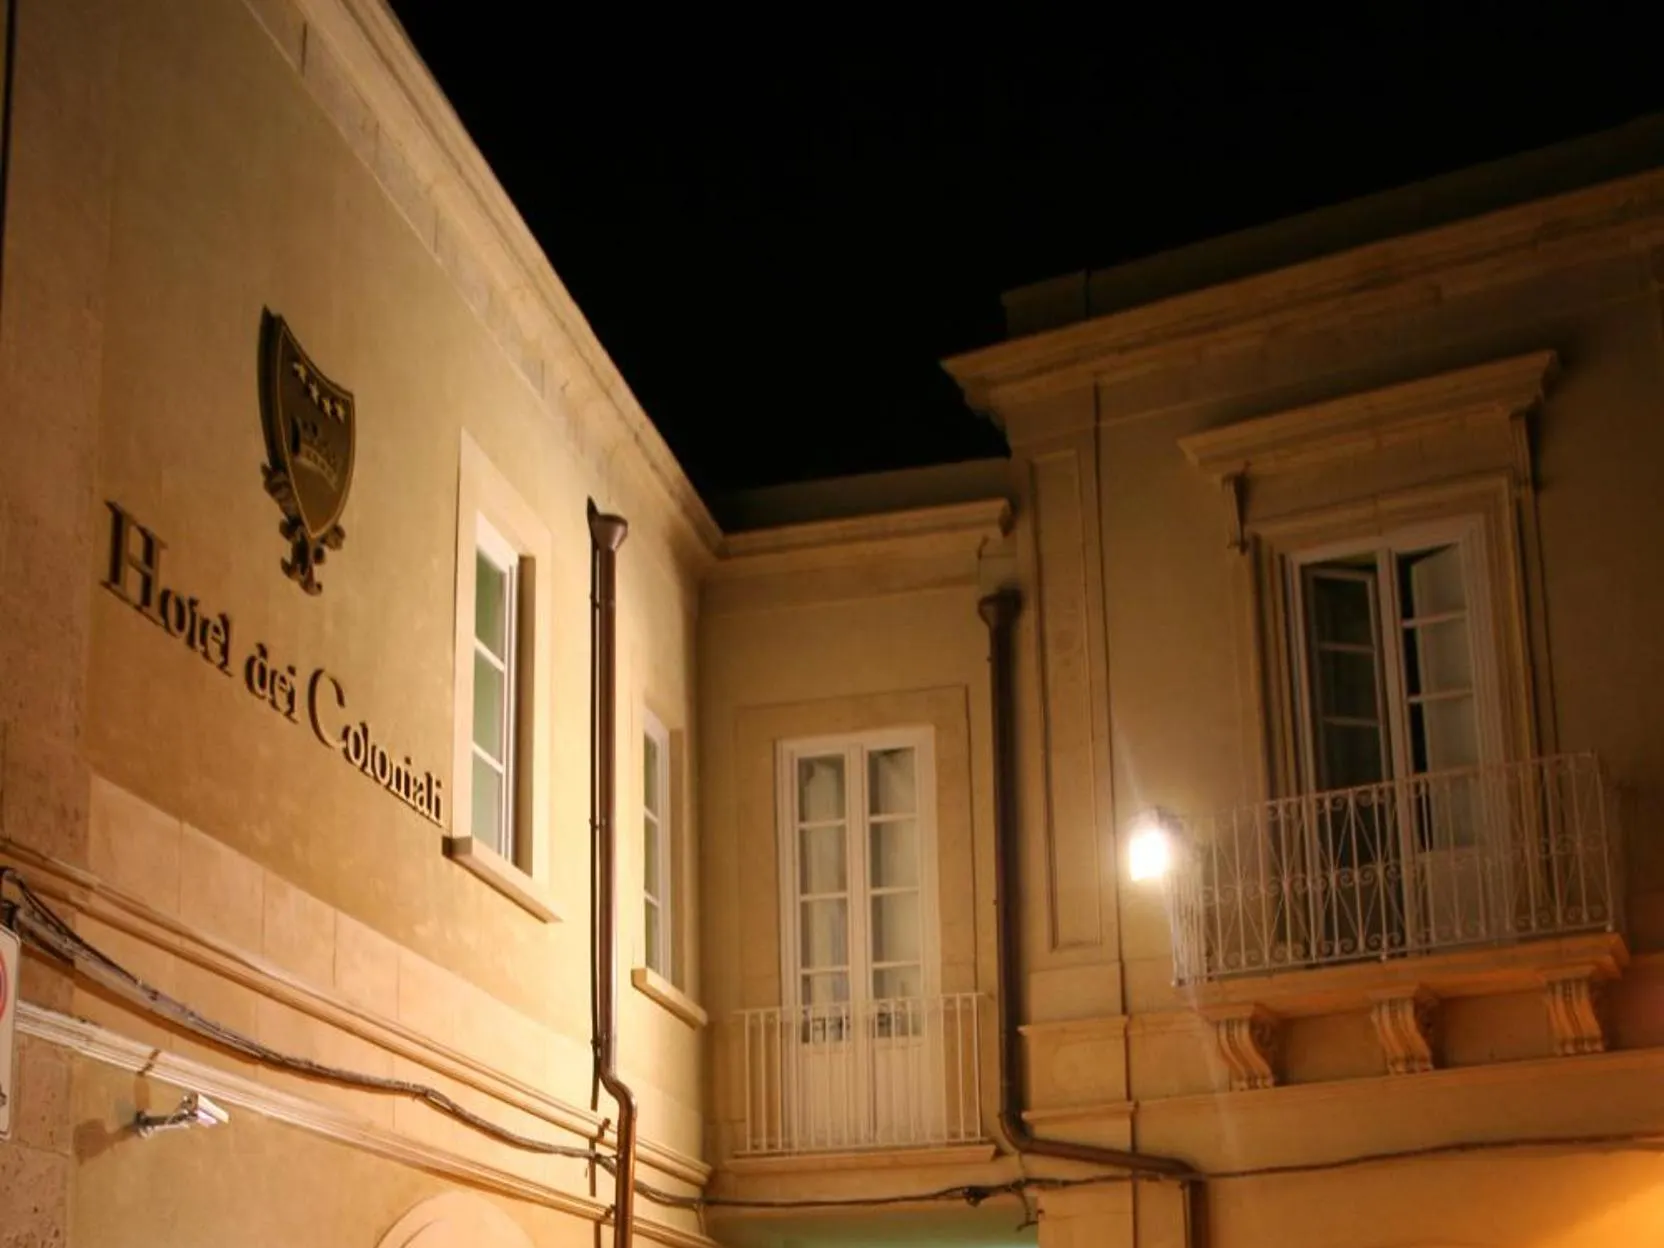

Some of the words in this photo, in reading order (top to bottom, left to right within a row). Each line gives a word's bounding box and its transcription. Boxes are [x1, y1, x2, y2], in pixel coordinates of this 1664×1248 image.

[100, 499, 234, 677] Hotel
[244, 642, 299, 725] dei
[307, 668, 443, 828] Coloniali
